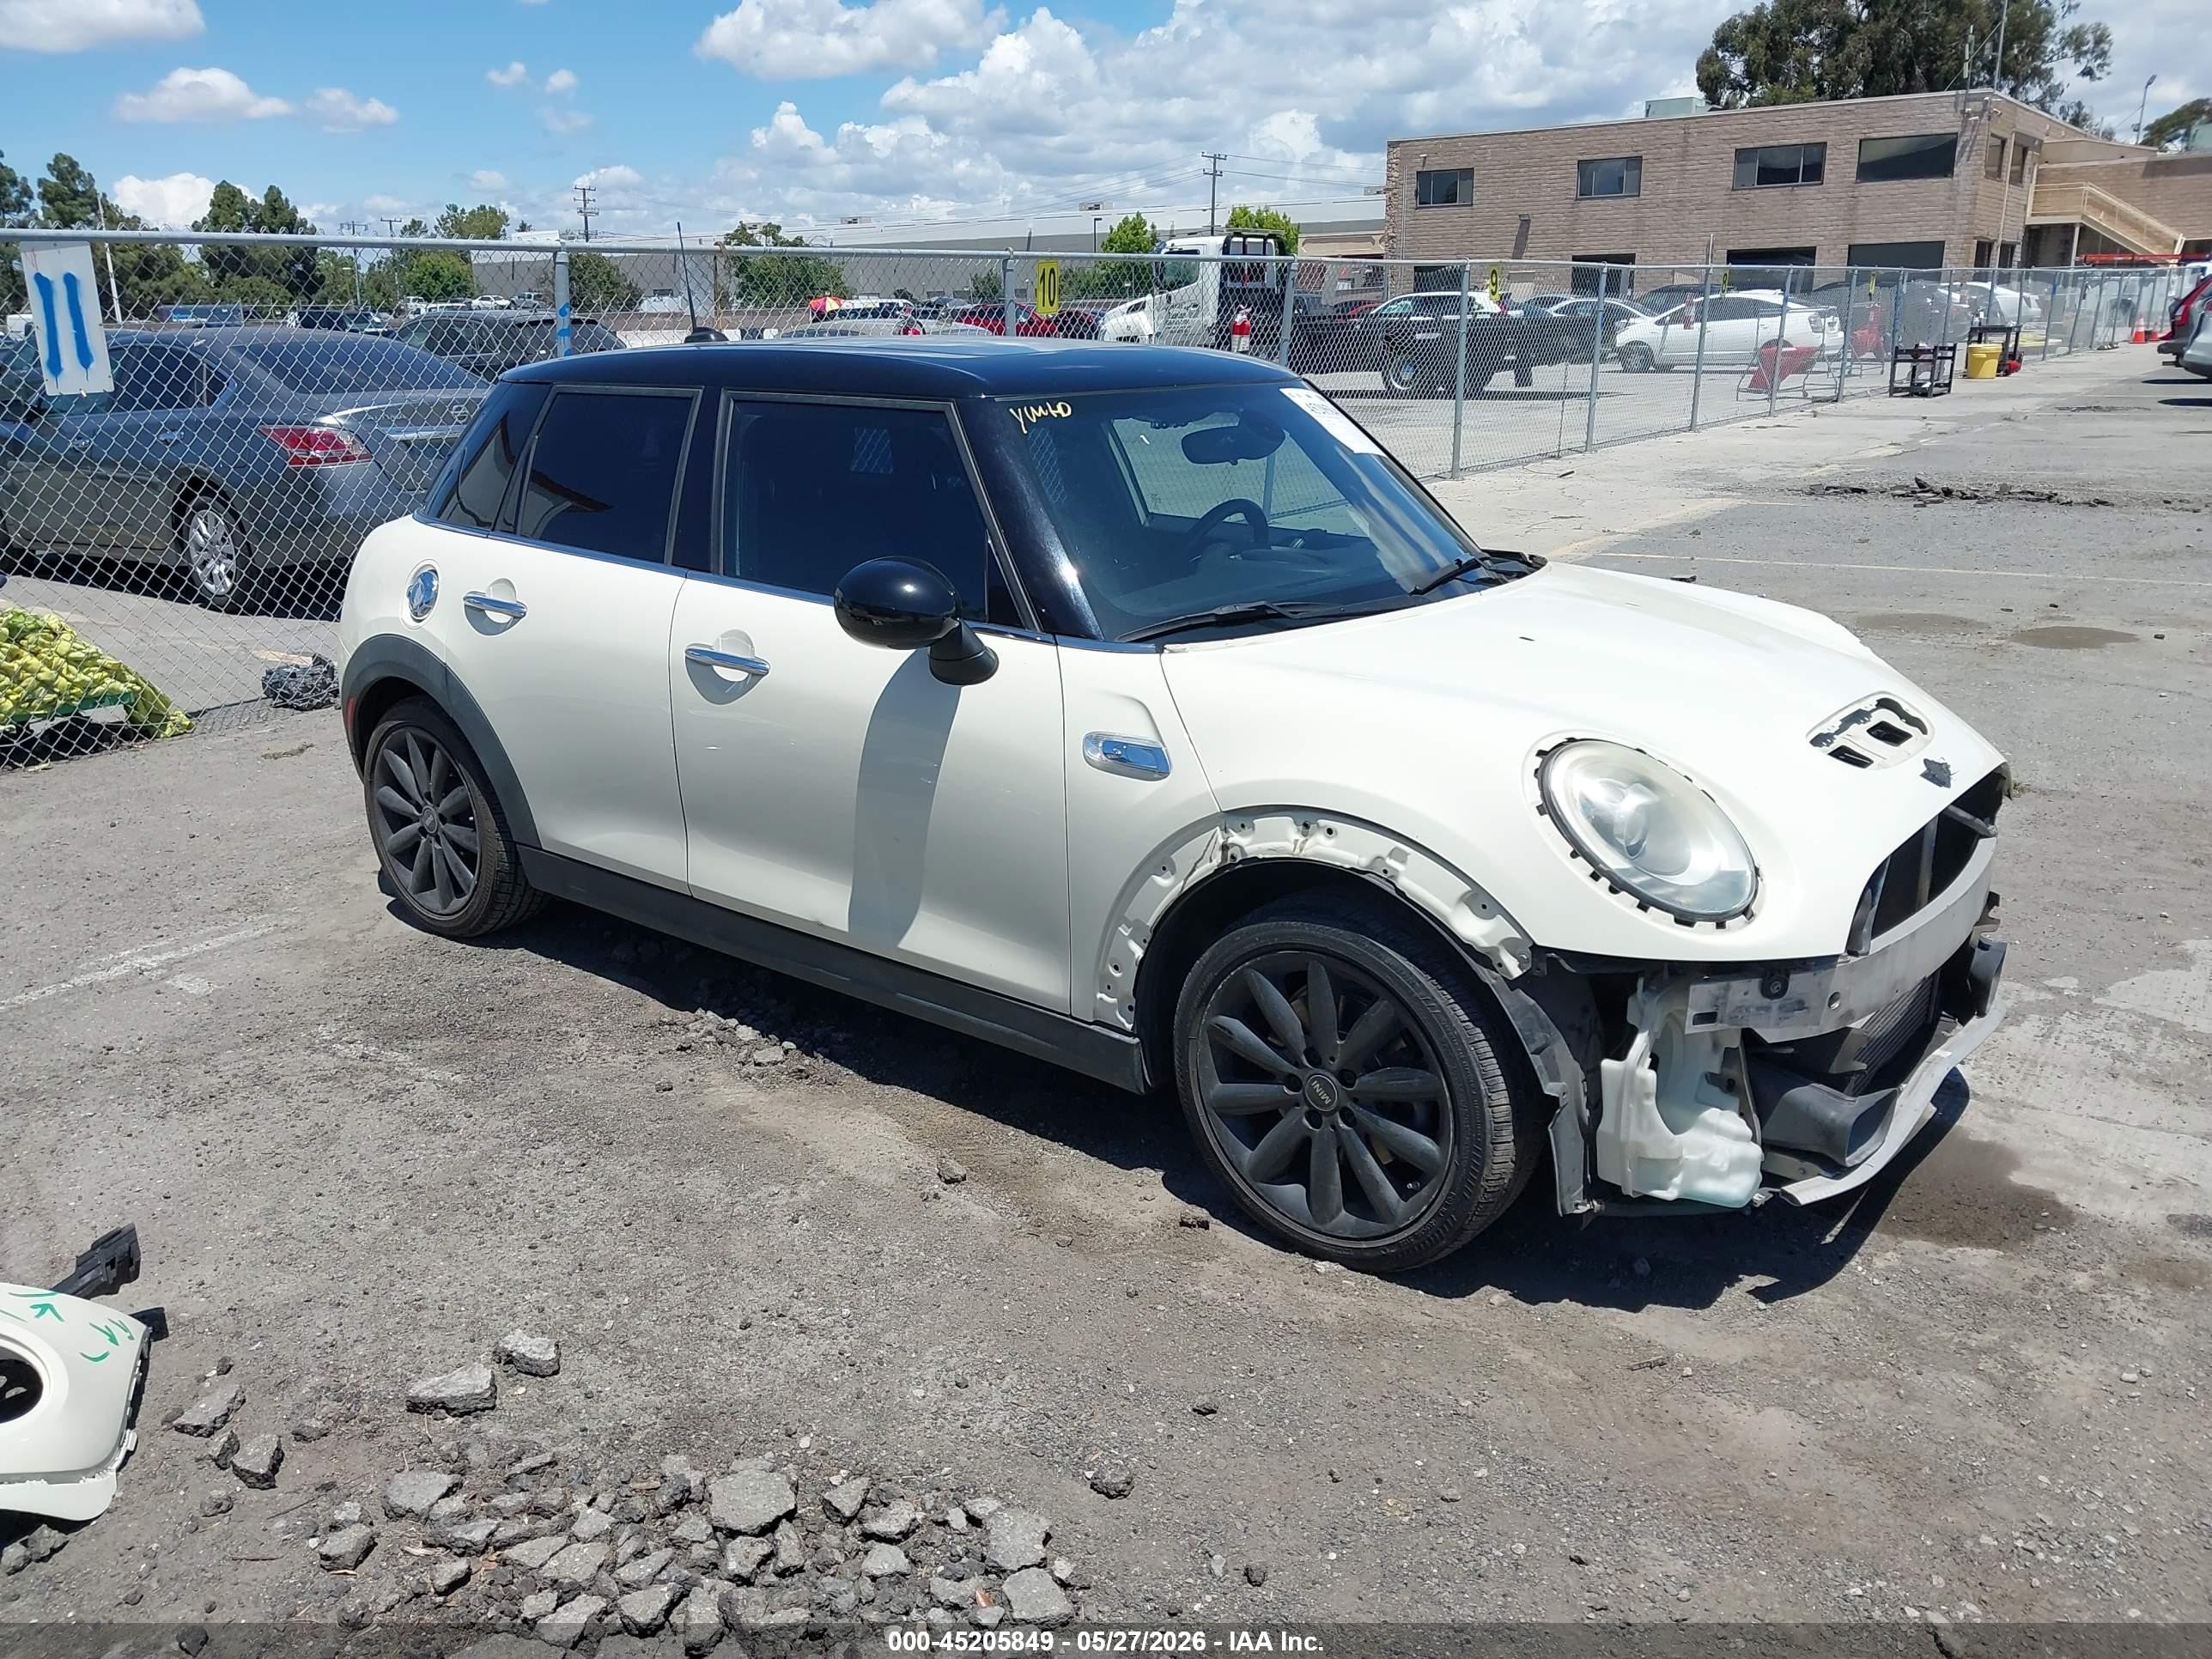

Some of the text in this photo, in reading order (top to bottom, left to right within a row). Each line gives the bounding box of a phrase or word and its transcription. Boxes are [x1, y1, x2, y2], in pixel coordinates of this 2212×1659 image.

[1039, 267, 1056, 307] 10
[1490, 269, 1498, 296] 9
[1721, 272, 1728, 294] 8
[33, 271, 94, 379] 11
[1311, 1080, 1332, 1105] MINI
